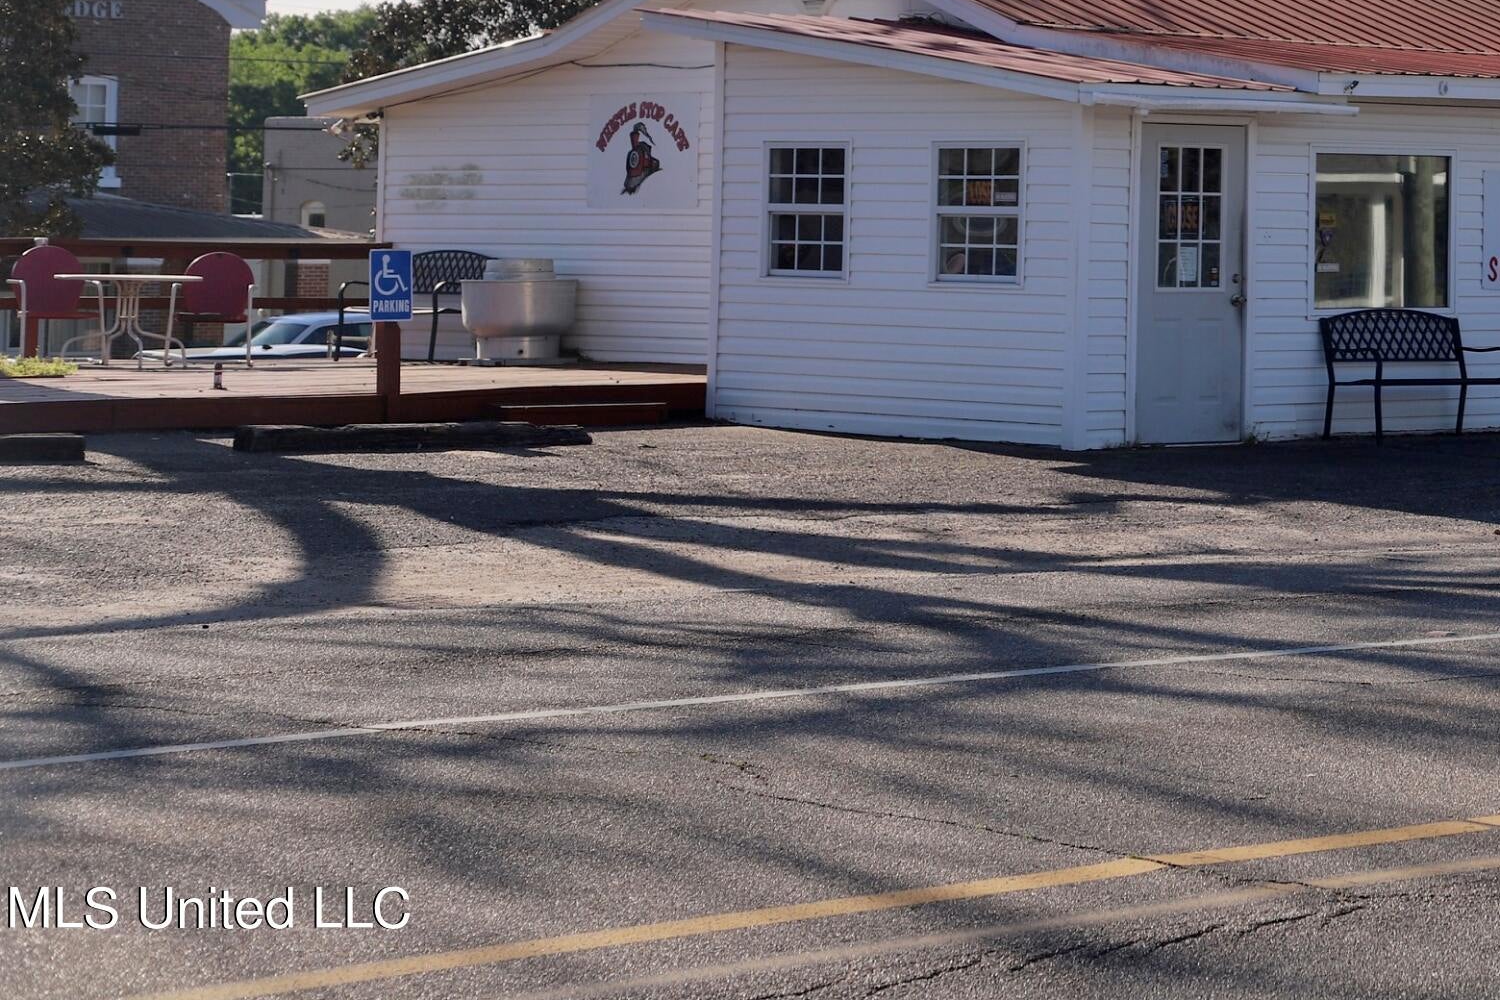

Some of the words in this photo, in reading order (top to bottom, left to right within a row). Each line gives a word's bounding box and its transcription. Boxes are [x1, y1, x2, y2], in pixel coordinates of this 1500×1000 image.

[596, 102, 637, 153] WHISTLE
[639, 101, 665, 122] STOP
[664, 113, 690, 152] CAFE
[373, 300, 410, 313] PARKING
